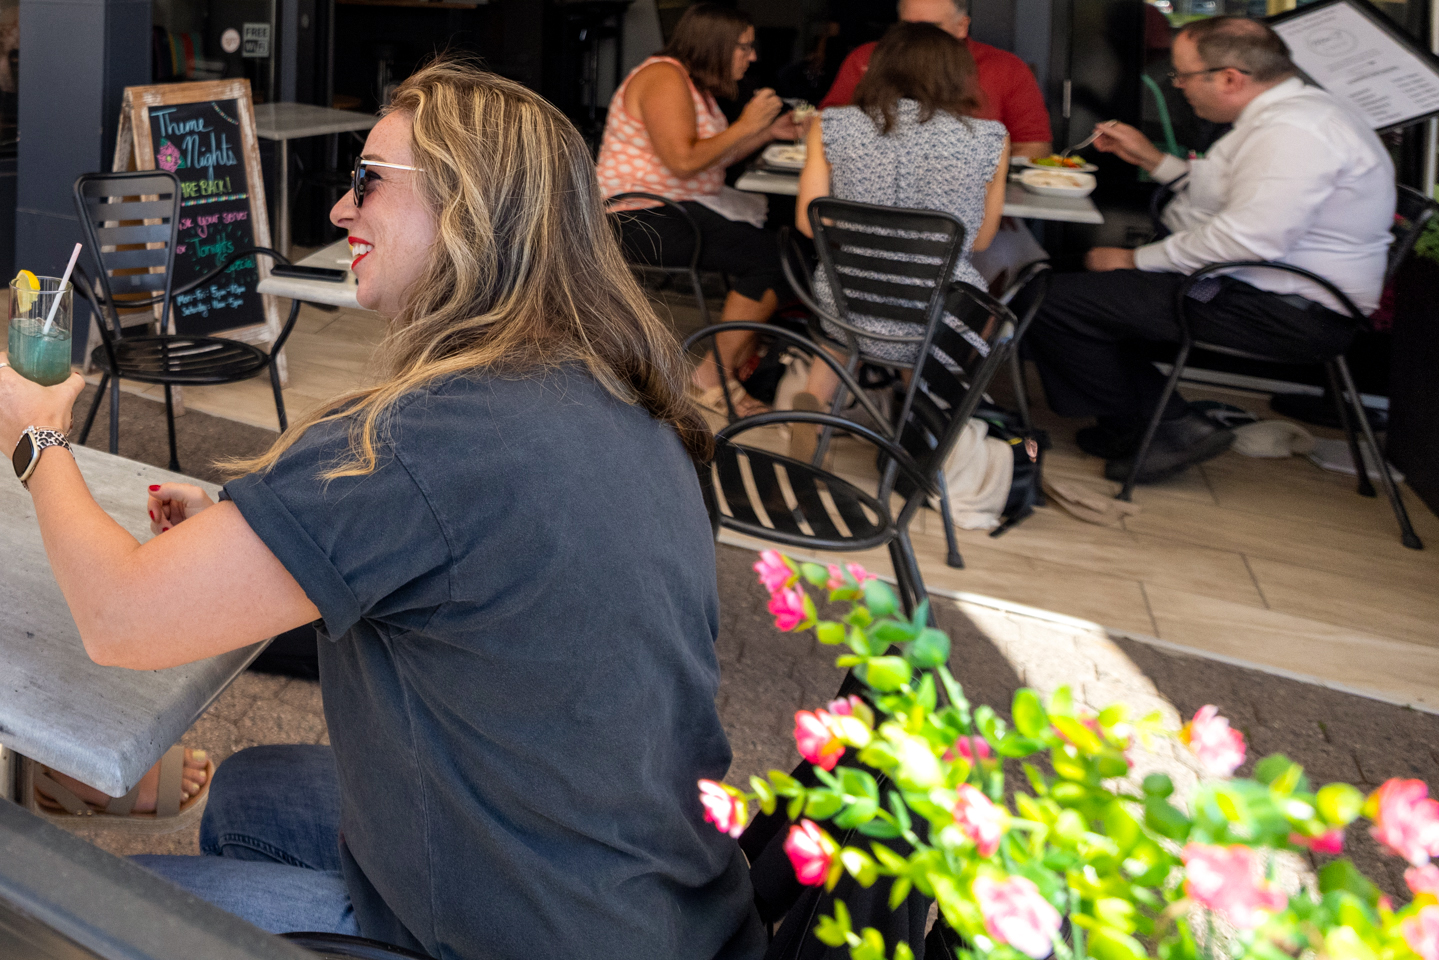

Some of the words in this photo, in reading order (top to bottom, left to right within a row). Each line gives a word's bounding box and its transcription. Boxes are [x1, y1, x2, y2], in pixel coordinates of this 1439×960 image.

[246, 28, 267, 38] FREE
[150, 107, 213, 137] Theme
[182, 132, 237, 181] Nights
[197, 214, 219, 238] your
